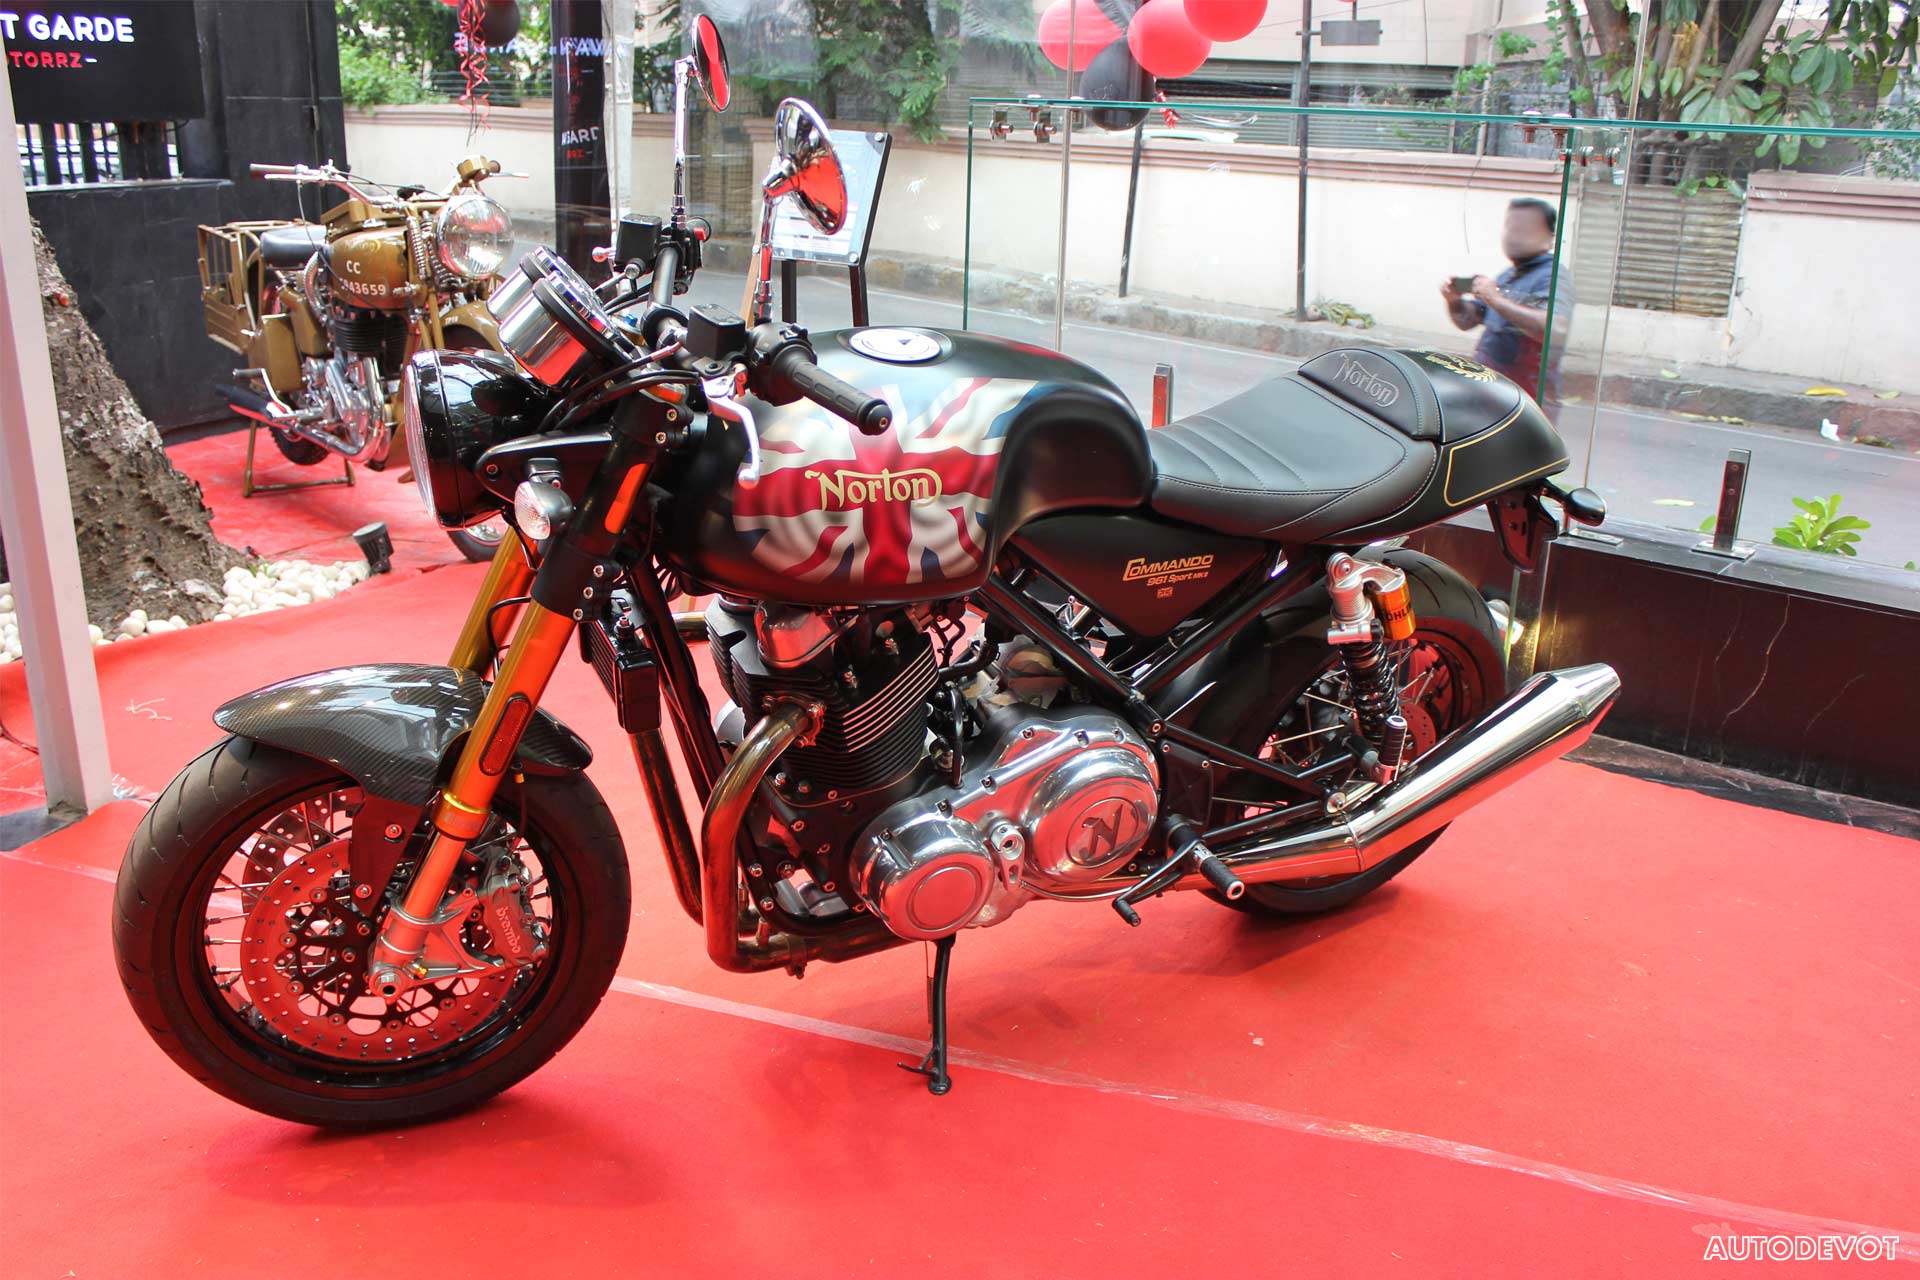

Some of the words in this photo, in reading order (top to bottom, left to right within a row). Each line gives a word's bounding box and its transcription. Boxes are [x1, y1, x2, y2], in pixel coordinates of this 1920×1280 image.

[27, 14, 135, 43] GARDE
[6, 51, 82, 68] TORRZ
[346, 260, 361, 274] CC
[1333, 353, 1399, 407] Norton
[805, 468, 943, 512] Norton
[1122, 554, 1214, 581] COMMANDO
[1146, 576, 1168, 586] 961
[1168, 573, 1193, 583] Sport
[496, 905, 522, 954] brembo
